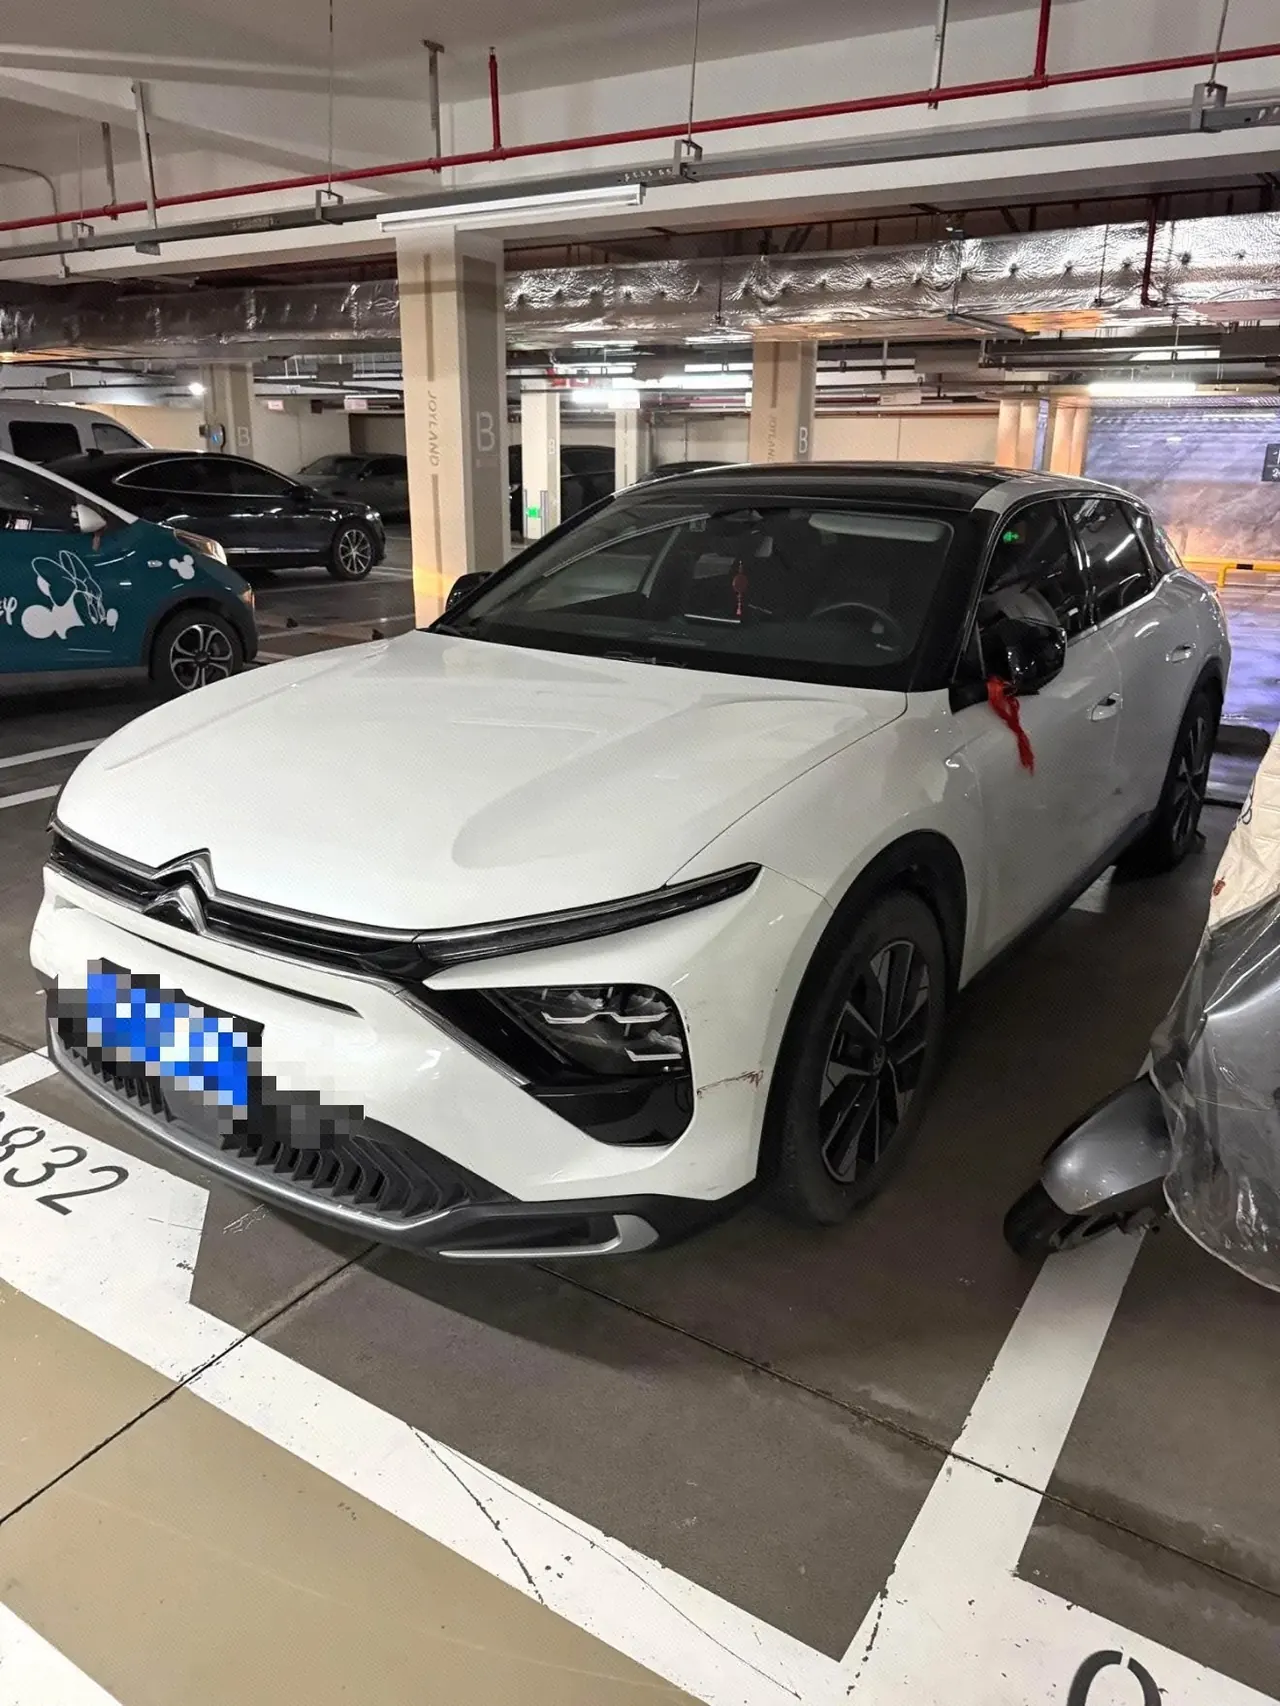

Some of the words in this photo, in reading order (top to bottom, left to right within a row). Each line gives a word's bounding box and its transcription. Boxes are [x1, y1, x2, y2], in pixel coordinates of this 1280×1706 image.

[238, 426, 249, 446] B
[428, 390, 440, 467] JOYLAND
[476, 411, 496, 451] B
[768, 414, 777, 461] JOYLAN
[799, 427, 808, 453] B
[0, 1111, 129, 1216] 832
